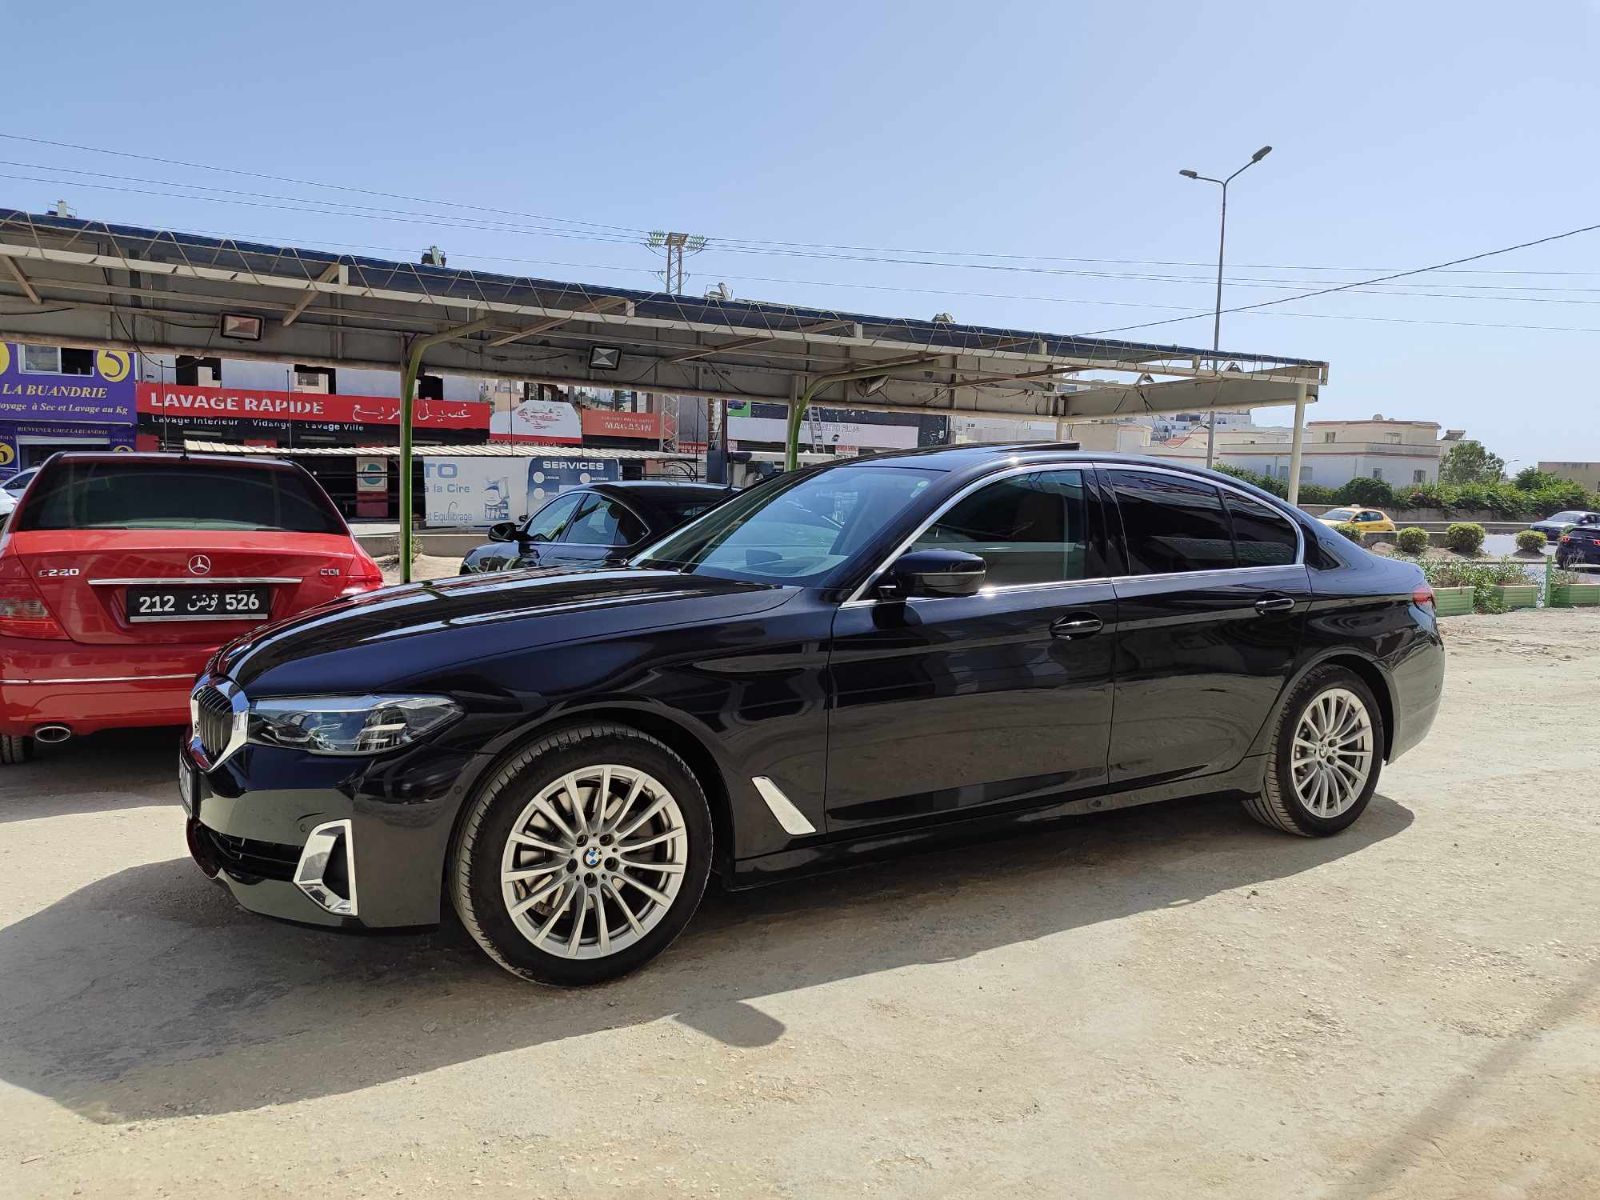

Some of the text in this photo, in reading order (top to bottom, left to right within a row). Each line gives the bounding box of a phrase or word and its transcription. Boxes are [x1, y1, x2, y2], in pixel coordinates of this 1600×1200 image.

[2, 383, 108, 398] LA BUANDRIE
[0, 402, 27, 411] oyage
[40, 403, 55, 411] Sec
[68, 404, 100, 413] Lavage
[116, 405, 128, 415] Kg
[151, 392, 324, 414] LAVAGE RAPIDE
[152, 415, 190, 426] Lavage
[252, 419, 292, 430] Vidange
[305, 422, 341, 432] Lavage
[343, 423, 364, 431] Ville
[424, 463, 458, 478] TO
[542, 460, 604, 470] SERVICES
[433, 484, 443, 493] la
[447, 483, 470, 493] Cire
[433, 511, 473, 524] Equilibrage
[38, 568, 80, 577] C220
[320, 568, 340, 576] CDI
[139, 593, 260, 613] 212 تونس 526
